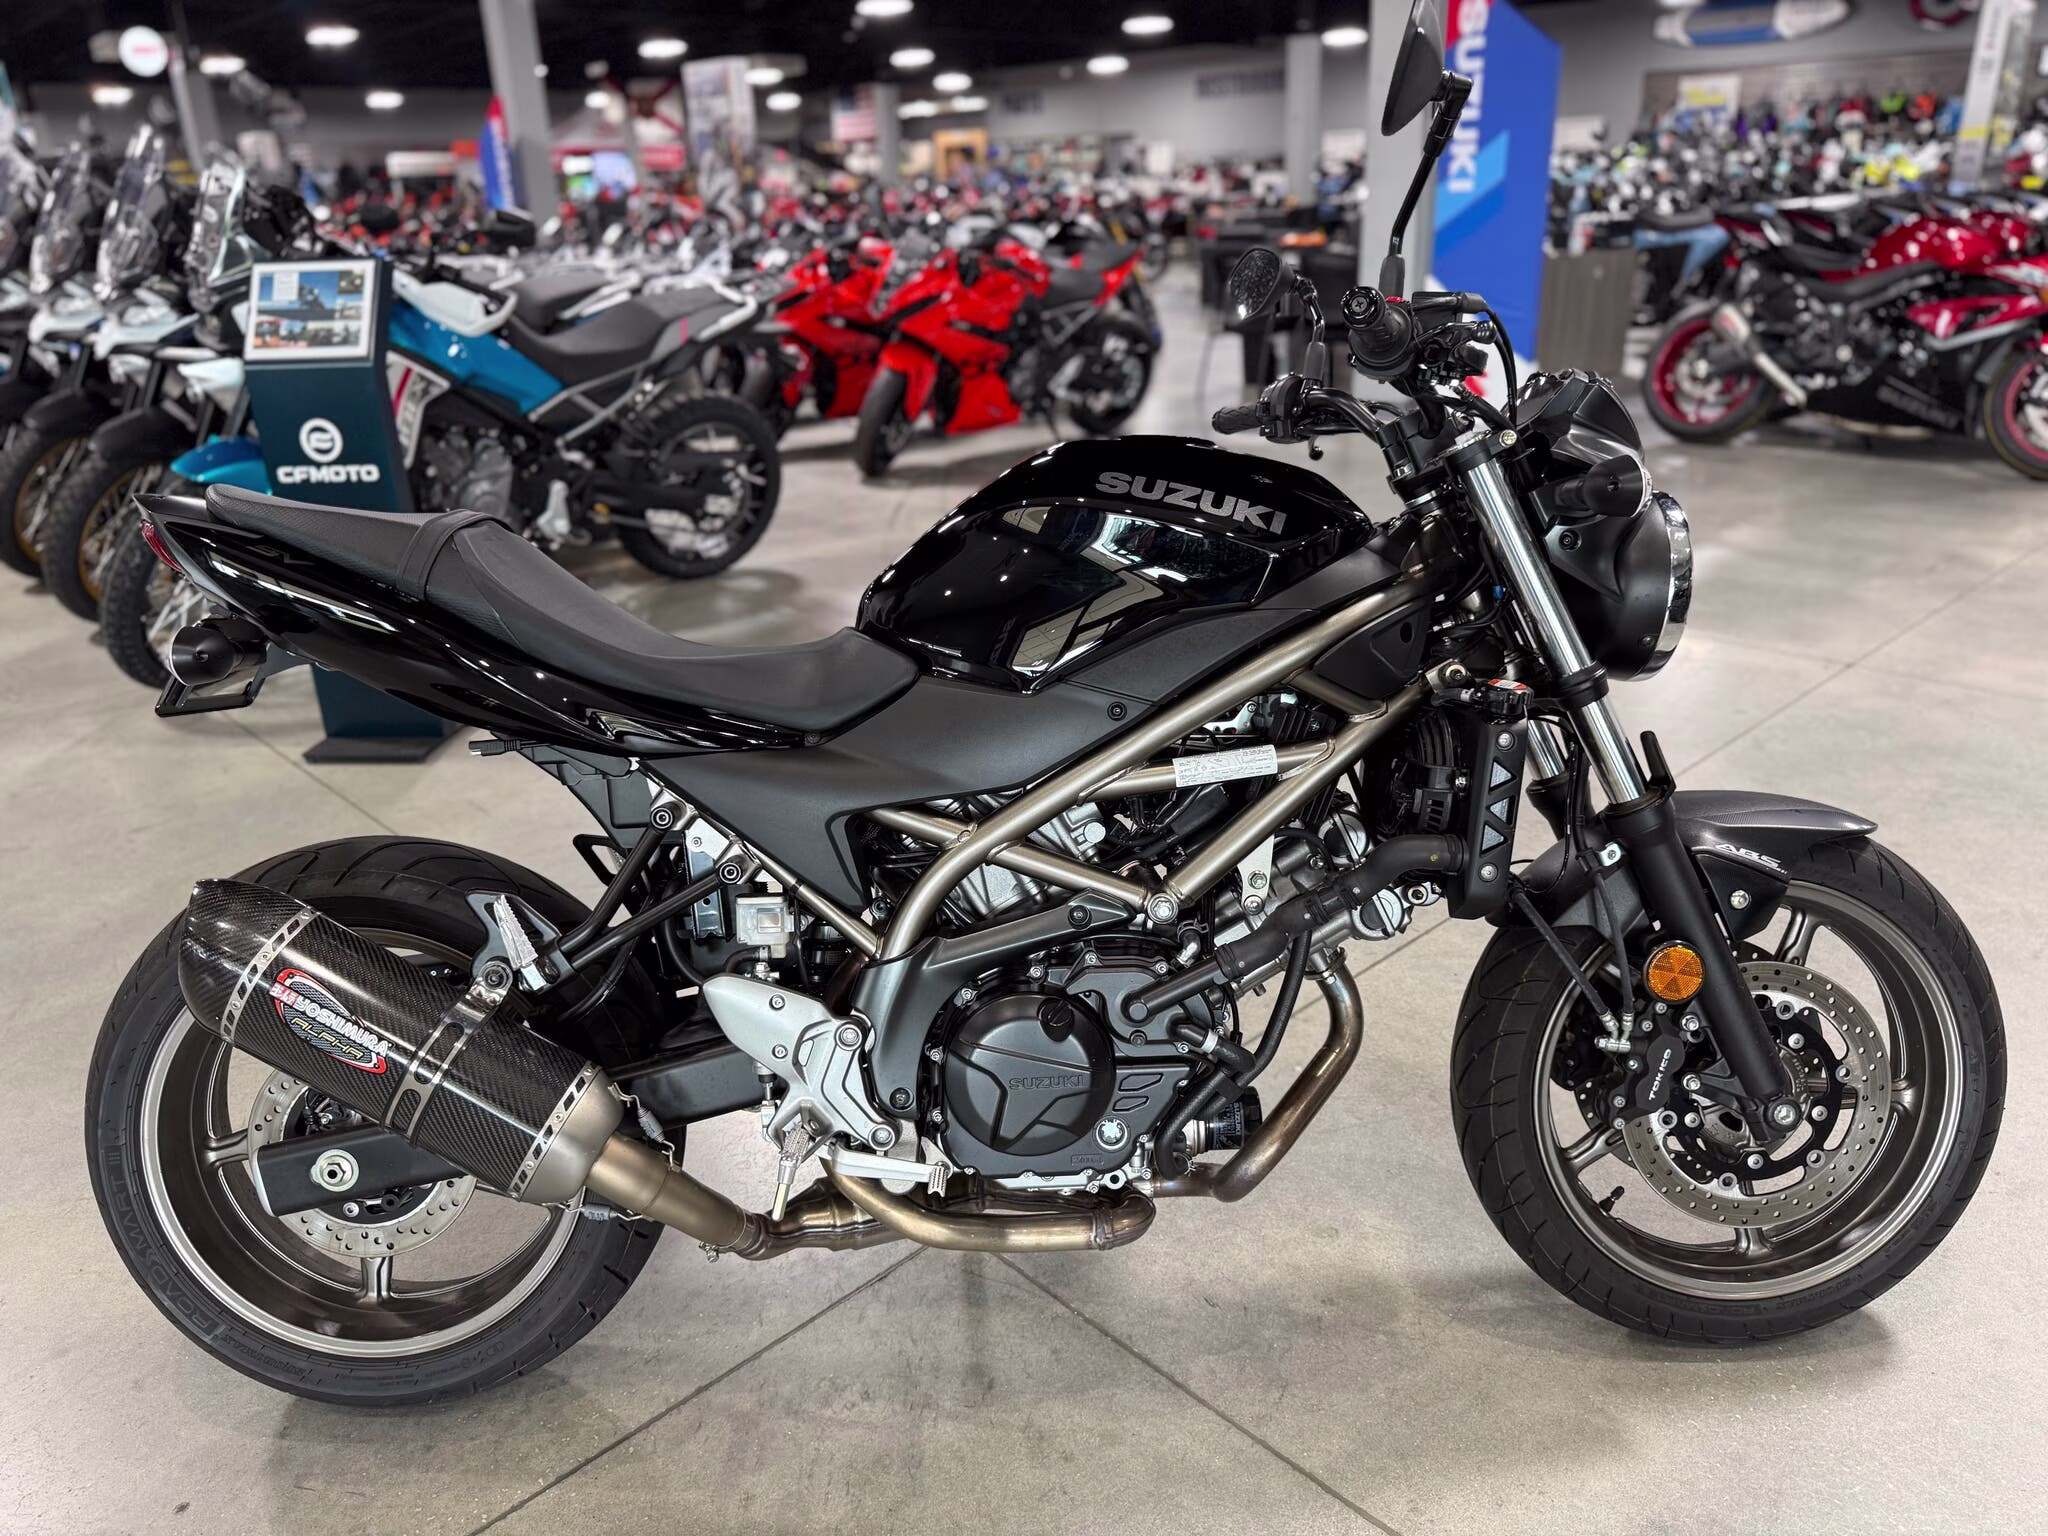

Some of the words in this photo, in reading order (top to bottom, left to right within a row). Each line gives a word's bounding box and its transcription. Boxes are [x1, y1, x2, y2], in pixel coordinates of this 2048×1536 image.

[276, 463, 380, 484] CFMOTO
[1096, 471, 1287, 535] SUZUKI
[1715, 844, 1782, 869] ABS
[291, 1017, 364, 1060] ALPHA
[294, 994, 391, 1057] YOSHIMURA
[1008, 1074, 1086, 1090] SUZUKI
[1648, 1048, 1672, 1101] TOKICO
